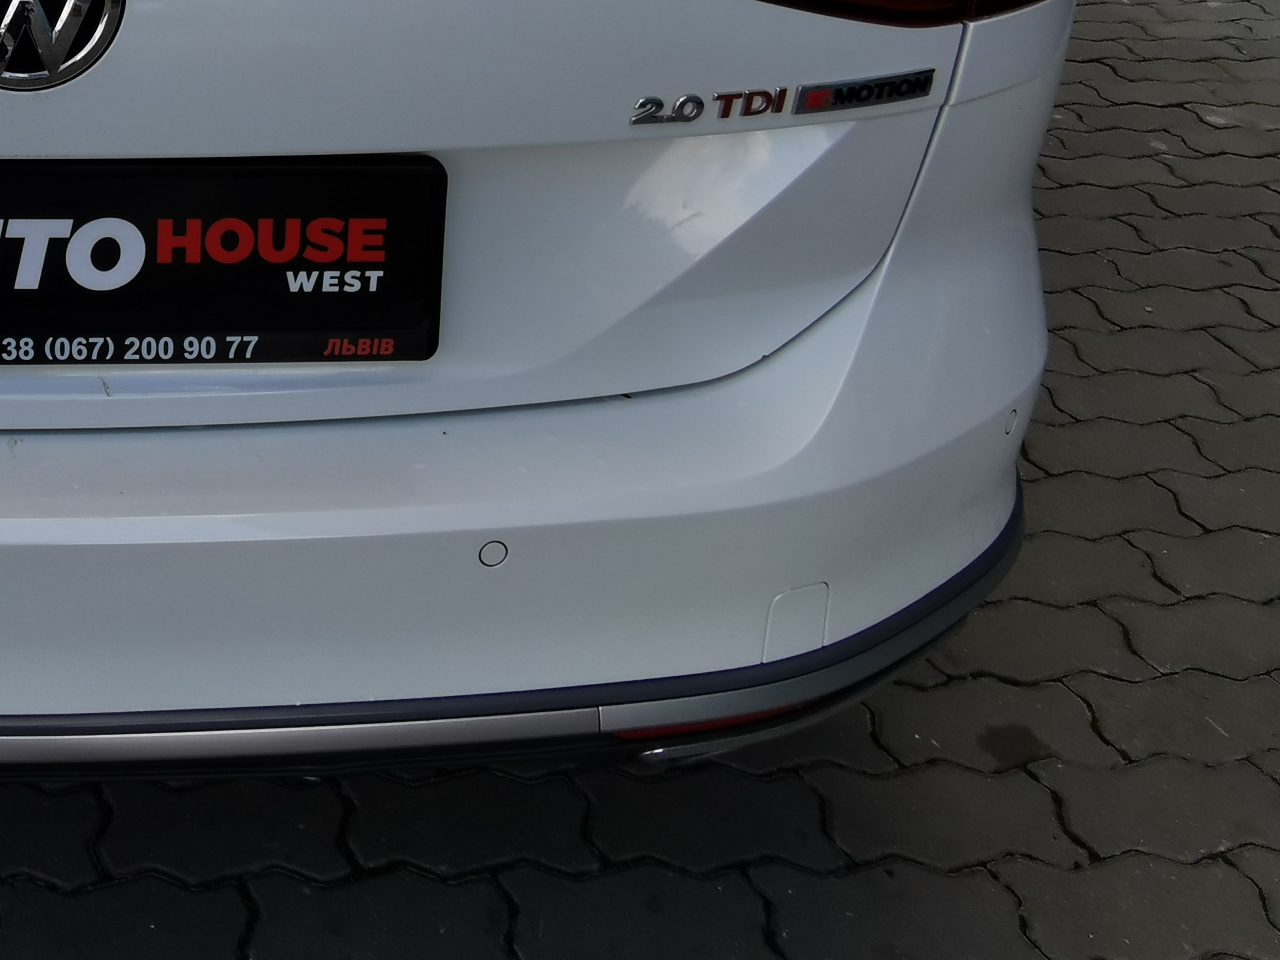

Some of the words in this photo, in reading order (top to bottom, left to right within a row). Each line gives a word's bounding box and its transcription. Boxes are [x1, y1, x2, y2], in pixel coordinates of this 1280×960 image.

[629, 94, 705, 125] 2.0
[712, 86, 788, 119] TDI
[286, 270, 385, 292] WEST
[1, 337, 35, 361] 38
[44, 336, 115, 361] (067)
[124, 337, 174, 360] 200
[183, 337, 217, 360] 90
[226, 335, 259, 359] 77
[323, 338, 395, 357] ЛЬВІВ
